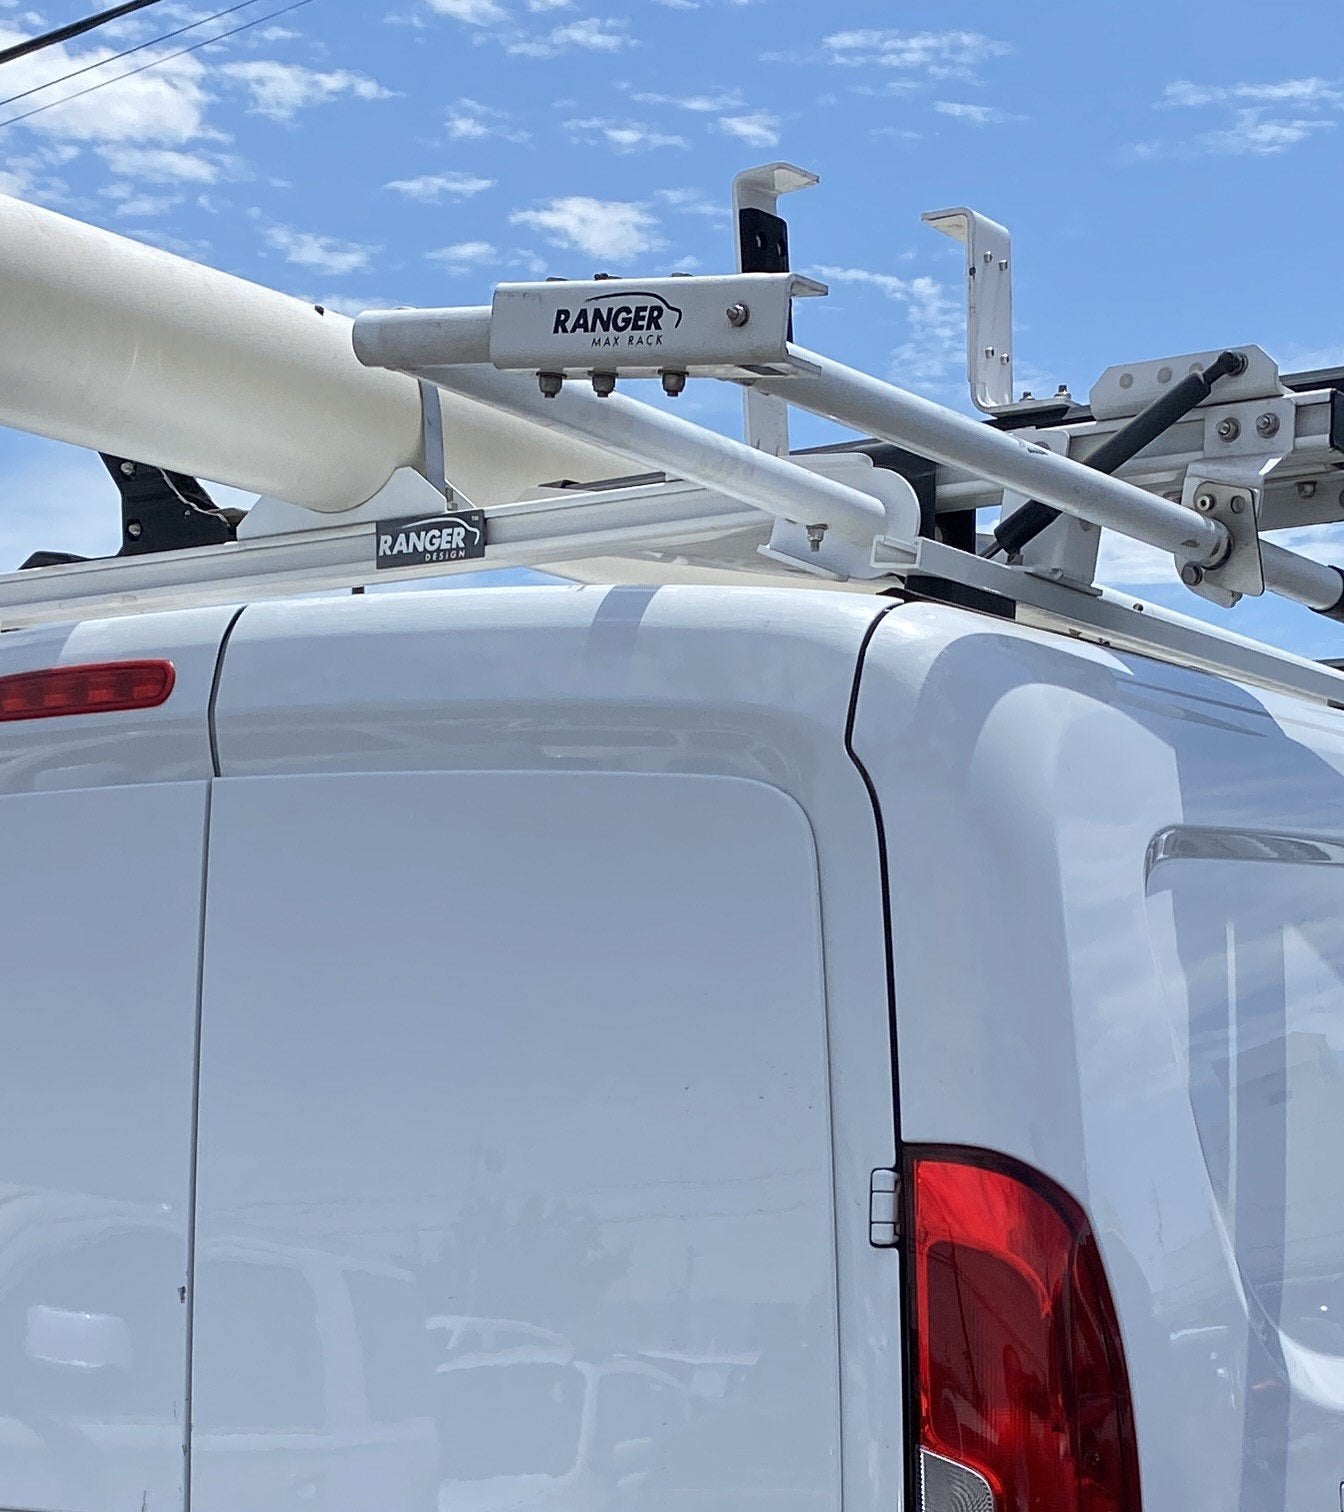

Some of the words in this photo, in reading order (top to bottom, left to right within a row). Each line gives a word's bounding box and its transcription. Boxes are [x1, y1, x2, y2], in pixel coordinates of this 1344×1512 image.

[553, 304, 664, 334] RANGER
[591, 336, 619, 348] MAX
[627, 333, 664, 347] RACK
[378, 526, 466, 557] RANGER
[424, 549, 466, 562] DESIGN
